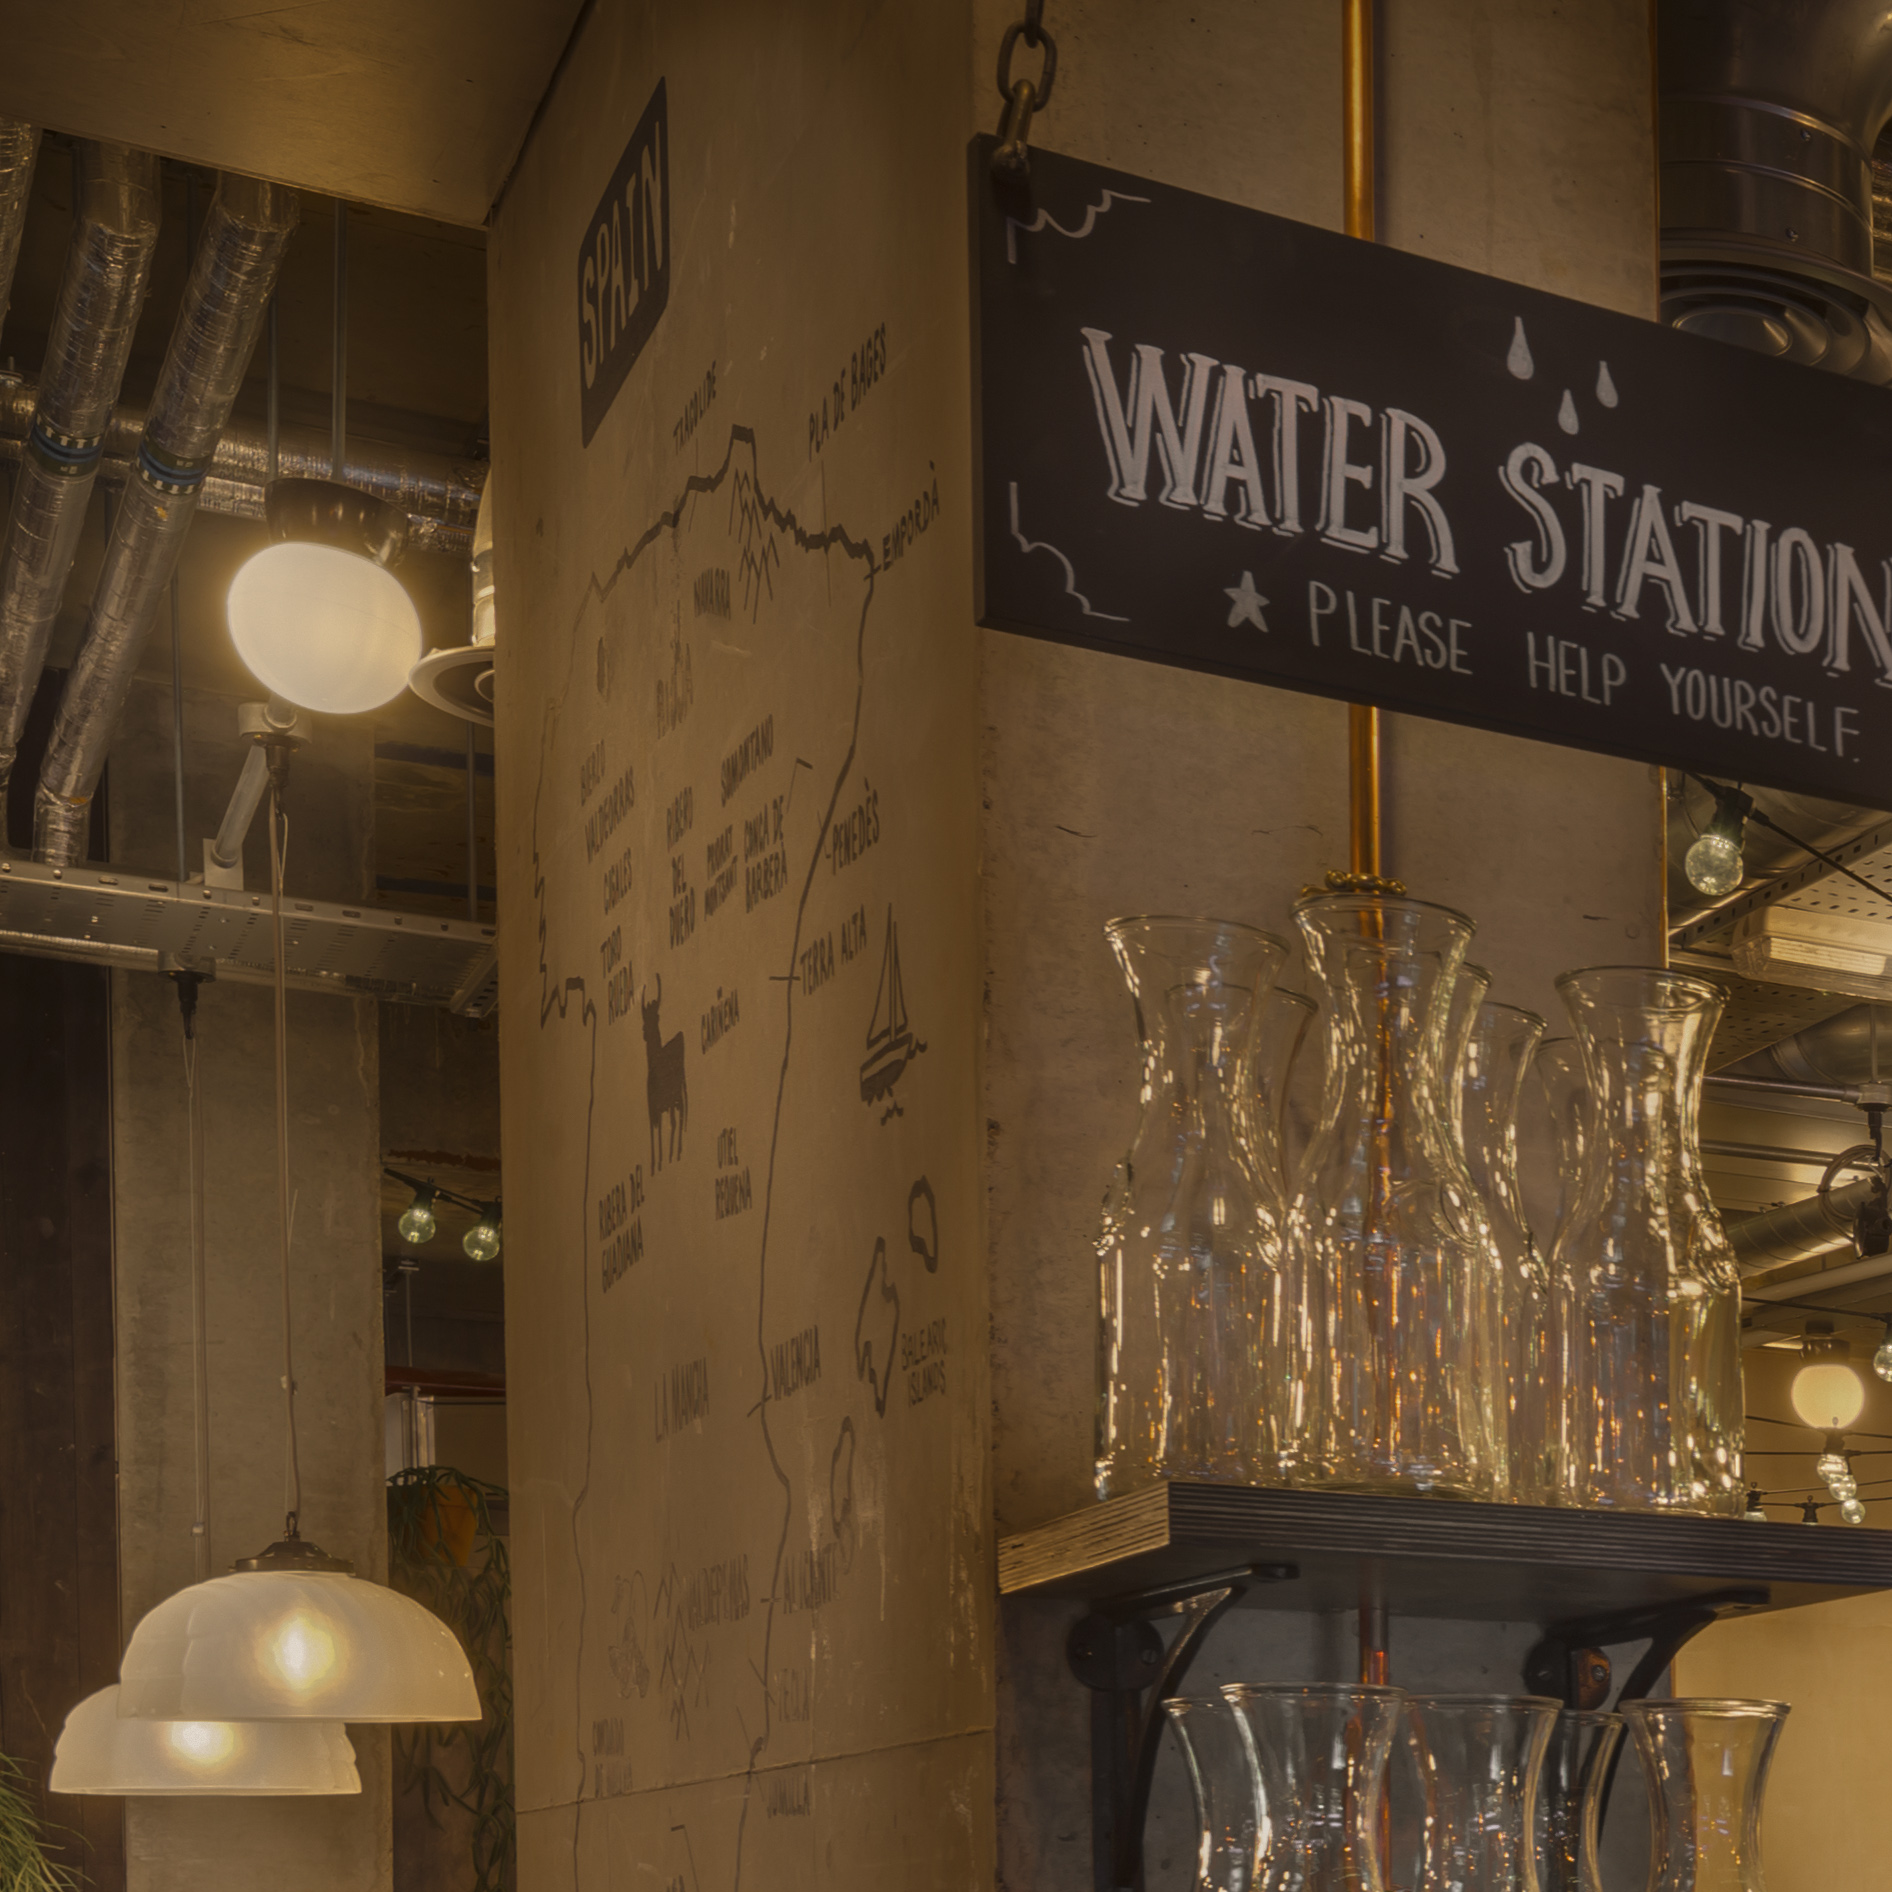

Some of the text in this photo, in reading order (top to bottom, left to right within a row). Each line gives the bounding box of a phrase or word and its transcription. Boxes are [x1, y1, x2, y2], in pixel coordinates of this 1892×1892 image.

[581, 119, 662, 390] SPAIN
[808, 321, 887, 462] PLA DE BAGES
[1080, 326, 1460, 579] WATER
[882, 460, 941, 571] EMPORDÀ
[694, 566, 732, 621] NAVARRA
[1306, 579, 1474, 677] PLEASE
[1527, 630, 1627, 707] HELP
[720, 714, 774, 807] SOMONTANO
[584, 766, 635, 864] VALDEORRAS
[744, 795, 785, 861] CONCA DE
[600, 925, 623, 979] TORO
[800, 904, 868, 997] TERRA ALTA
[607, 962, 635, 1026] RUEDA
[717, 1127, 739, 1169] UTIEL
[598, 1165, 645, 1242] RIBERA DEL
[714, 1167, 753, 1221] REQUENA
[601, 1216, 645, 1293] GUADIANA
[770, 1325, 822, 1402] VALENCIA
[901, 1317, 948, 1372] BALEARIC
[654, 1356, 710, 1444] LA MANCHA
[908, 1361, 947, 1408] ISLANDS
